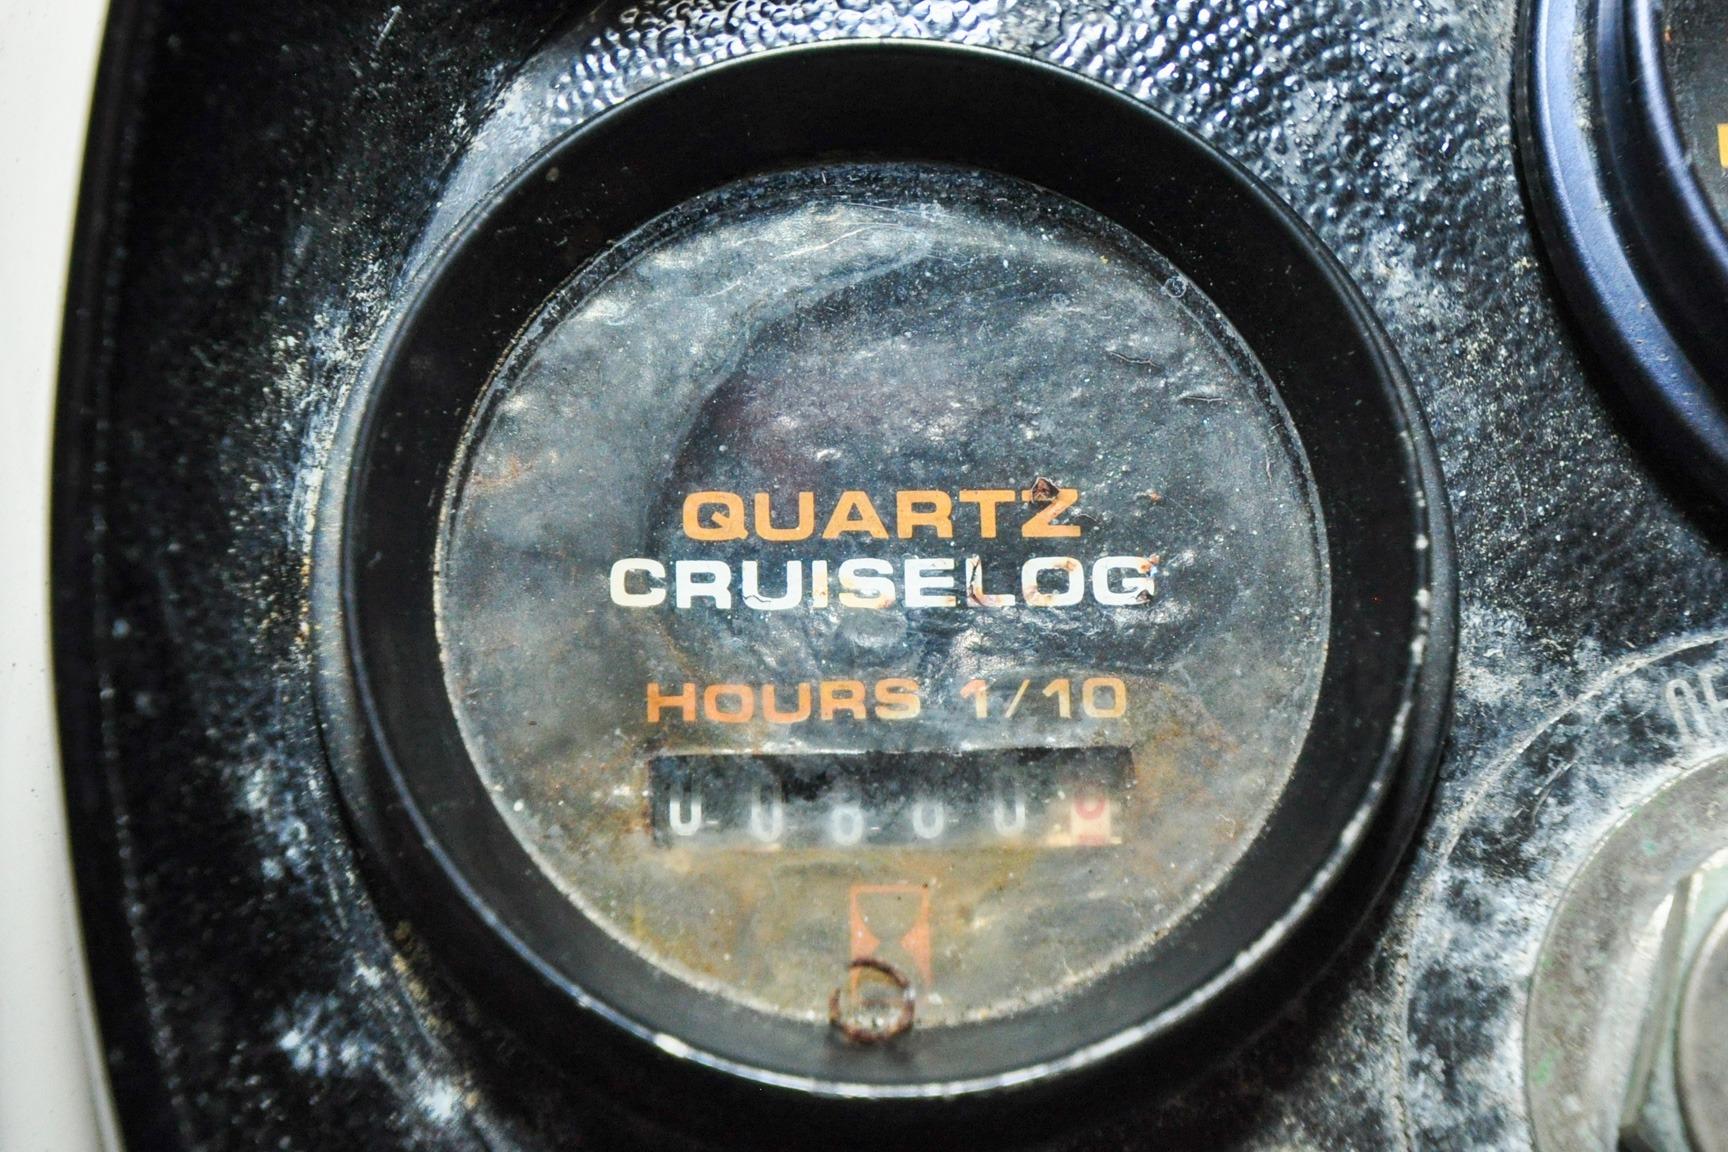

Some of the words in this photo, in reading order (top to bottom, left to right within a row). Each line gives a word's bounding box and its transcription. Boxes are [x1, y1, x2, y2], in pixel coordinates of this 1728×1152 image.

[682, 489, 1082, 541] QUARTZ
[609, 555, 1156, 611] CRUISELOG
[646, 677, 920, 724] HOURS
[960, 676, 1128, 720] 1/10
